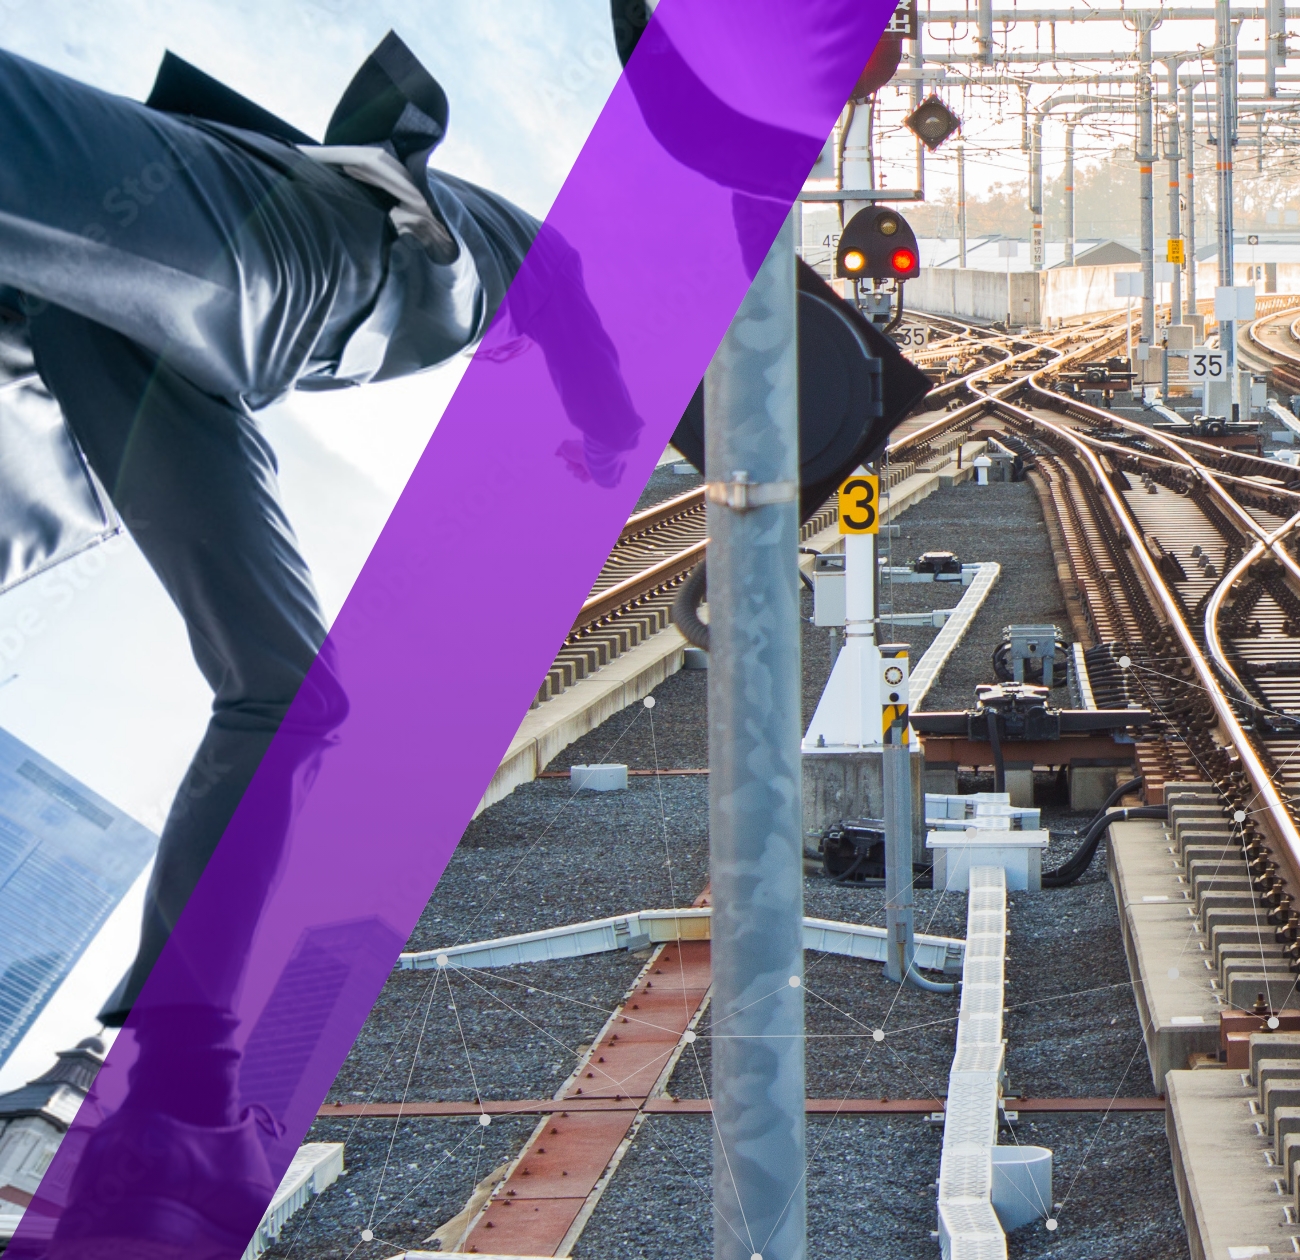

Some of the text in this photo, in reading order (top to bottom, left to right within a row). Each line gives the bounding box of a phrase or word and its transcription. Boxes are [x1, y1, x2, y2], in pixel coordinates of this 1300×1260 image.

[822, 234, 840, 248] 45
[900, 328, 924, 345] 35
[1193, 354, 1222, 377] 35
[842, 479, 876, 531] 3
